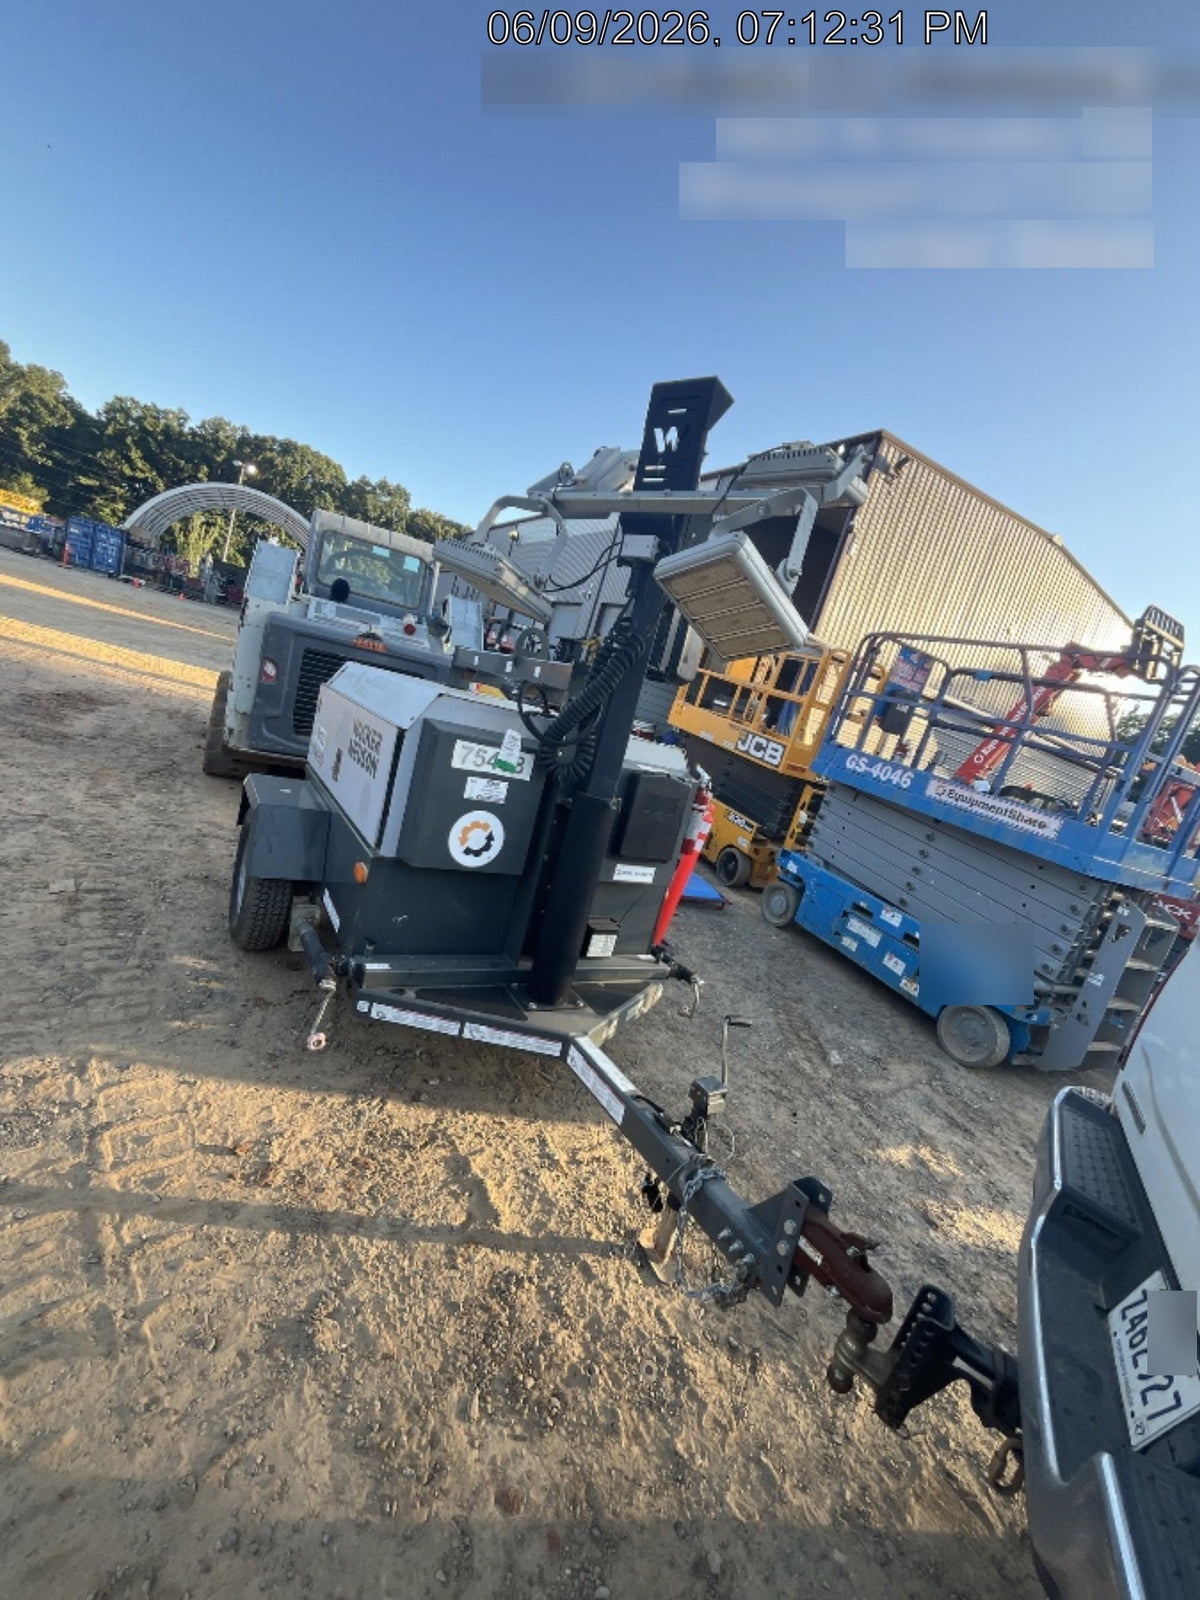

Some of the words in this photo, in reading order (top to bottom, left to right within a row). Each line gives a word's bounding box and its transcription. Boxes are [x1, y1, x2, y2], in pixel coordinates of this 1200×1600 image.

[460, 743, 525, 774] 7543
[736, 733, 786, 766] JCB
[845, 753, 915, 788] GS-4046
[948, 787, 1047, 830] EquipmentShare
